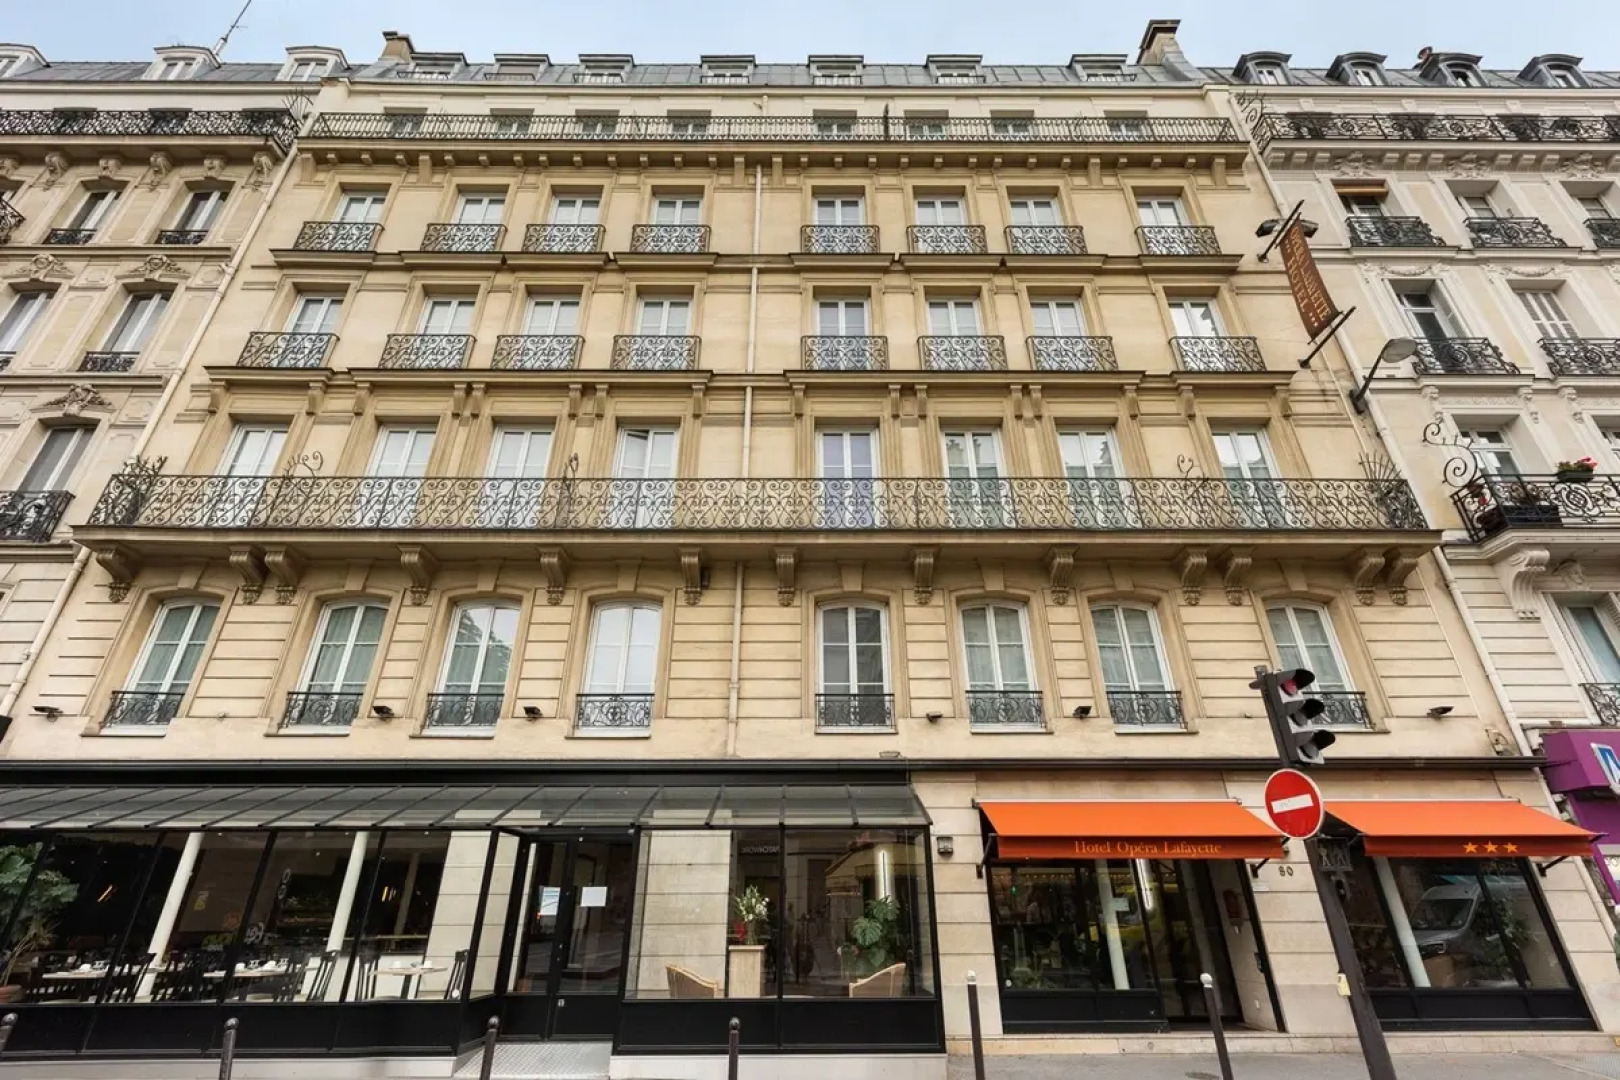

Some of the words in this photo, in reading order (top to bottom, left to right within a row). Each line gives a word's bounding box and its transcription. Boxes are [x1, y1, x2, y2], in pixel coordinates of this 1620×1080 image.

[1287, 256, 1308, 312] HOTEL
[1074, 840, 1111, 854] Hotel
[1117, 840, 1158, 857] Opéra
[1164, 840, 1222, 857] Lafayette
[1279, 866, 1294, 877] 80
